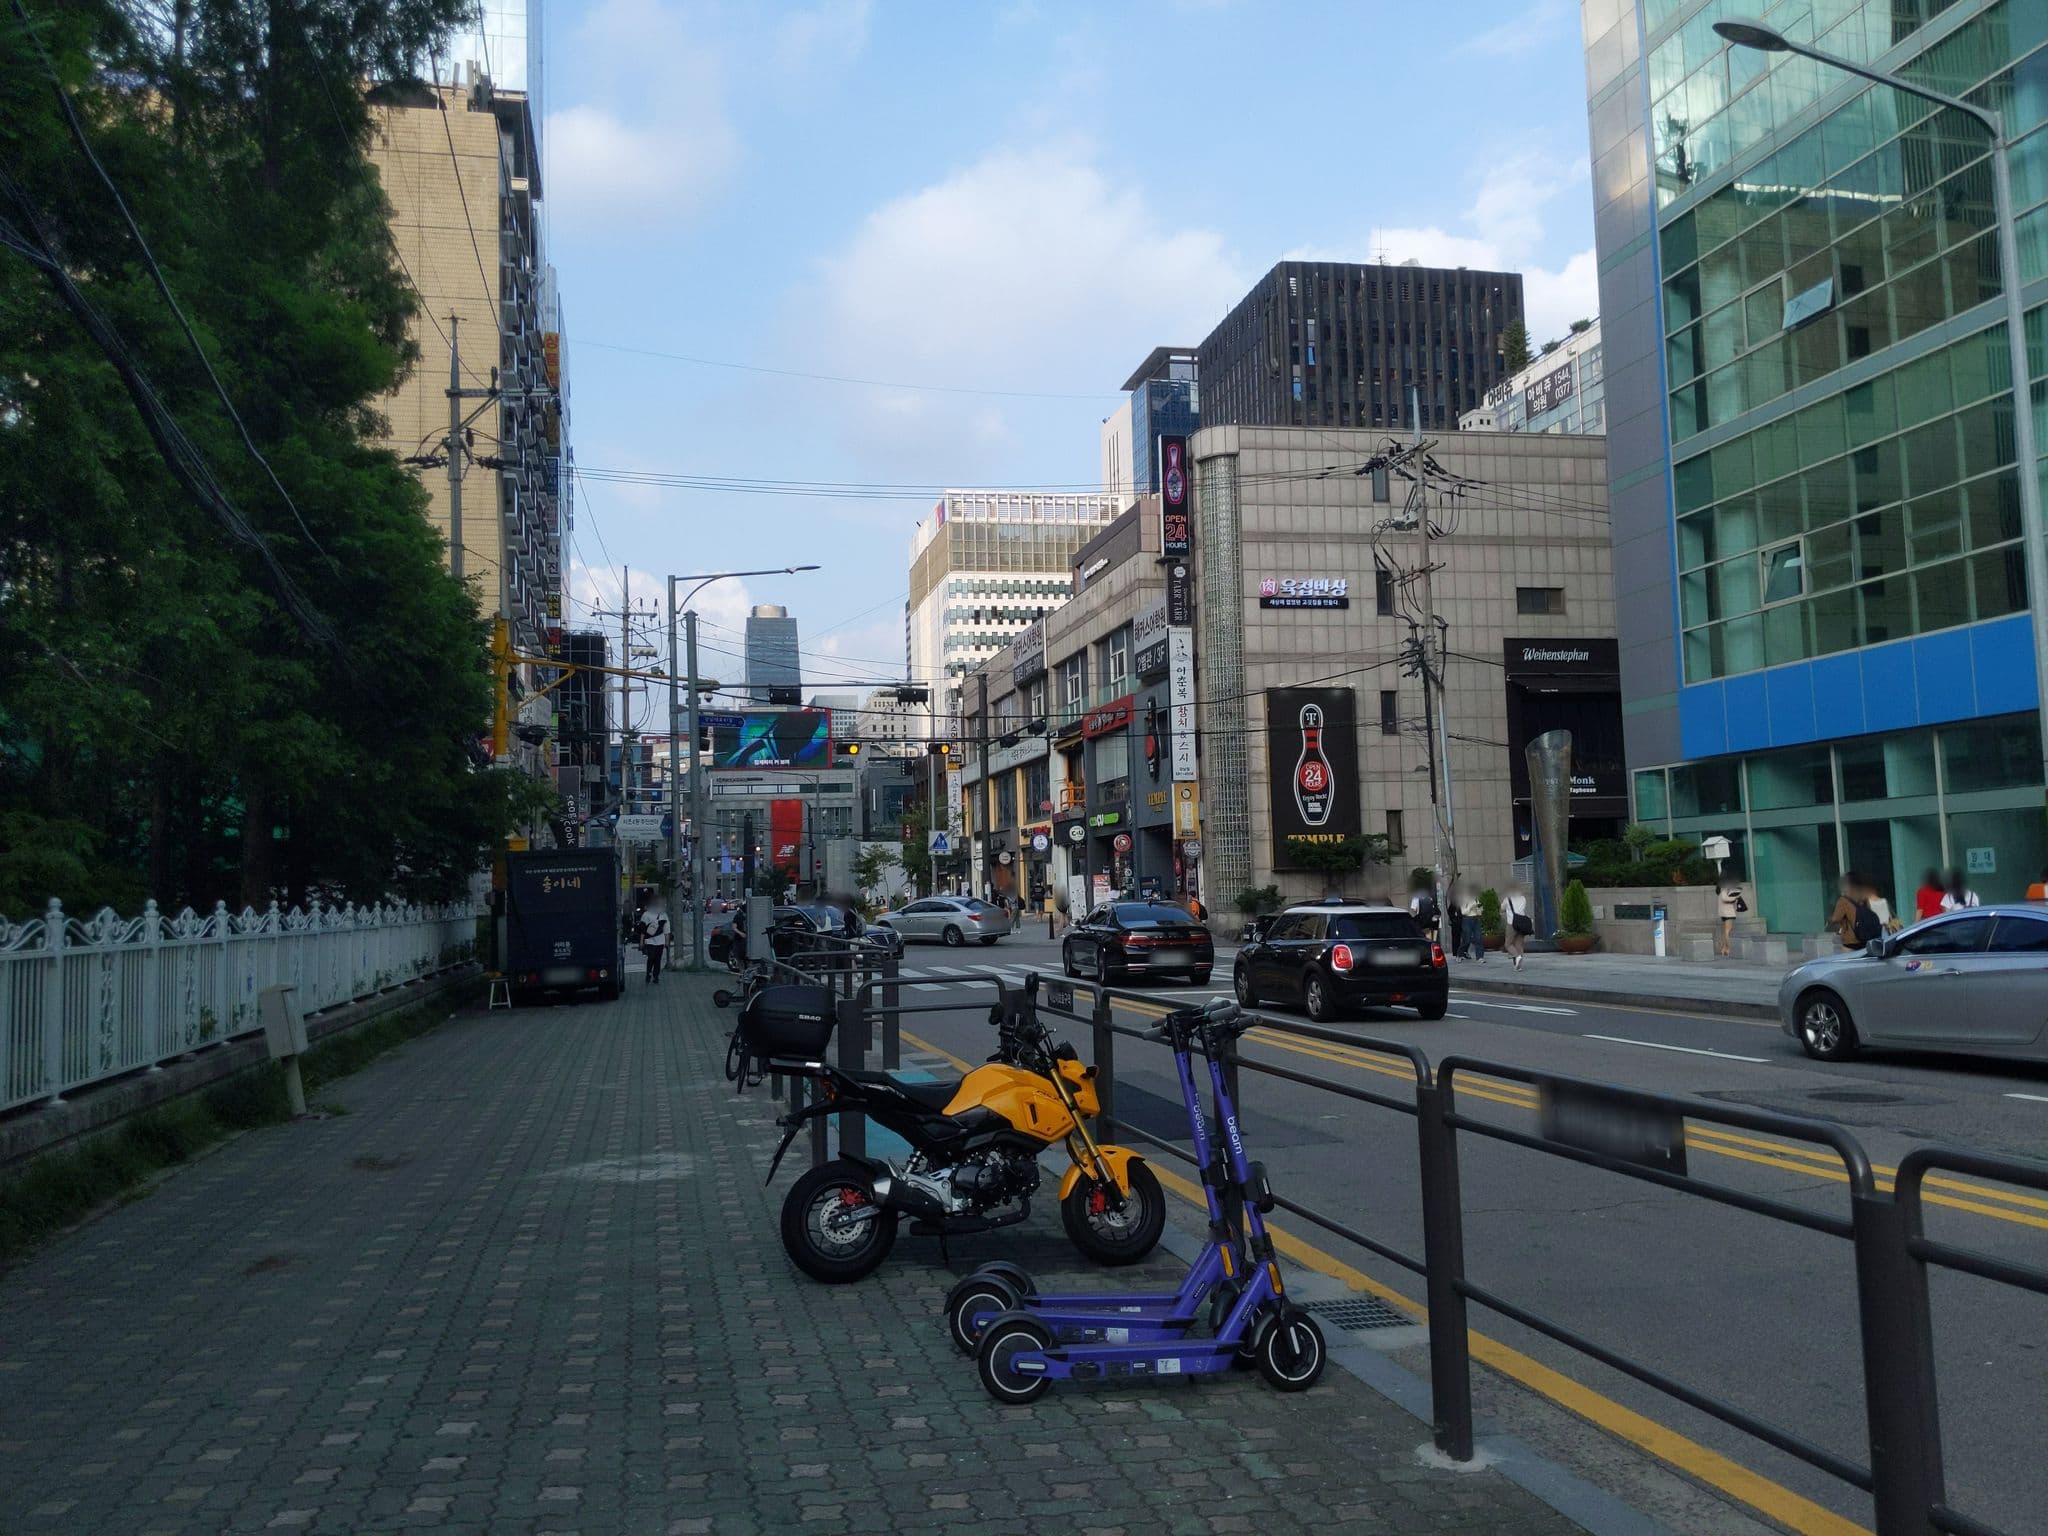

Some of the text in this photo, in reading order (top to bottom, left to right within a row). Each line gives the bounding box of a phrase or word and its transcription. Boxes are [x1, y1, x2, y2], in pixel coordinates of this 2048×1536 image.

[1527, 377, 1552, 401] 아비쥬
[1555, 381, 1571, 400] 0377
[1534, 395, 1547, 411] 의원
[1166, 515, 1186, 523] OPEN
[1166, 524, 1187, 541] 24
[1166, 541, 1187, 549] HOURS
[1134, 606, 1166, 642] 해커스어학원
[1156, 645, 1165, 664] 3F
[1522, 647, 1589, 663] Weihenstephan
[1176, 665, 1189, 699] 이춘복
[1177, 704, 1189, 728] 참치
[1178, 741, 1190, 763] 스시
[1305, 769, 1322, 782] 24
[1227, 1115, 1243, 1154] beam
